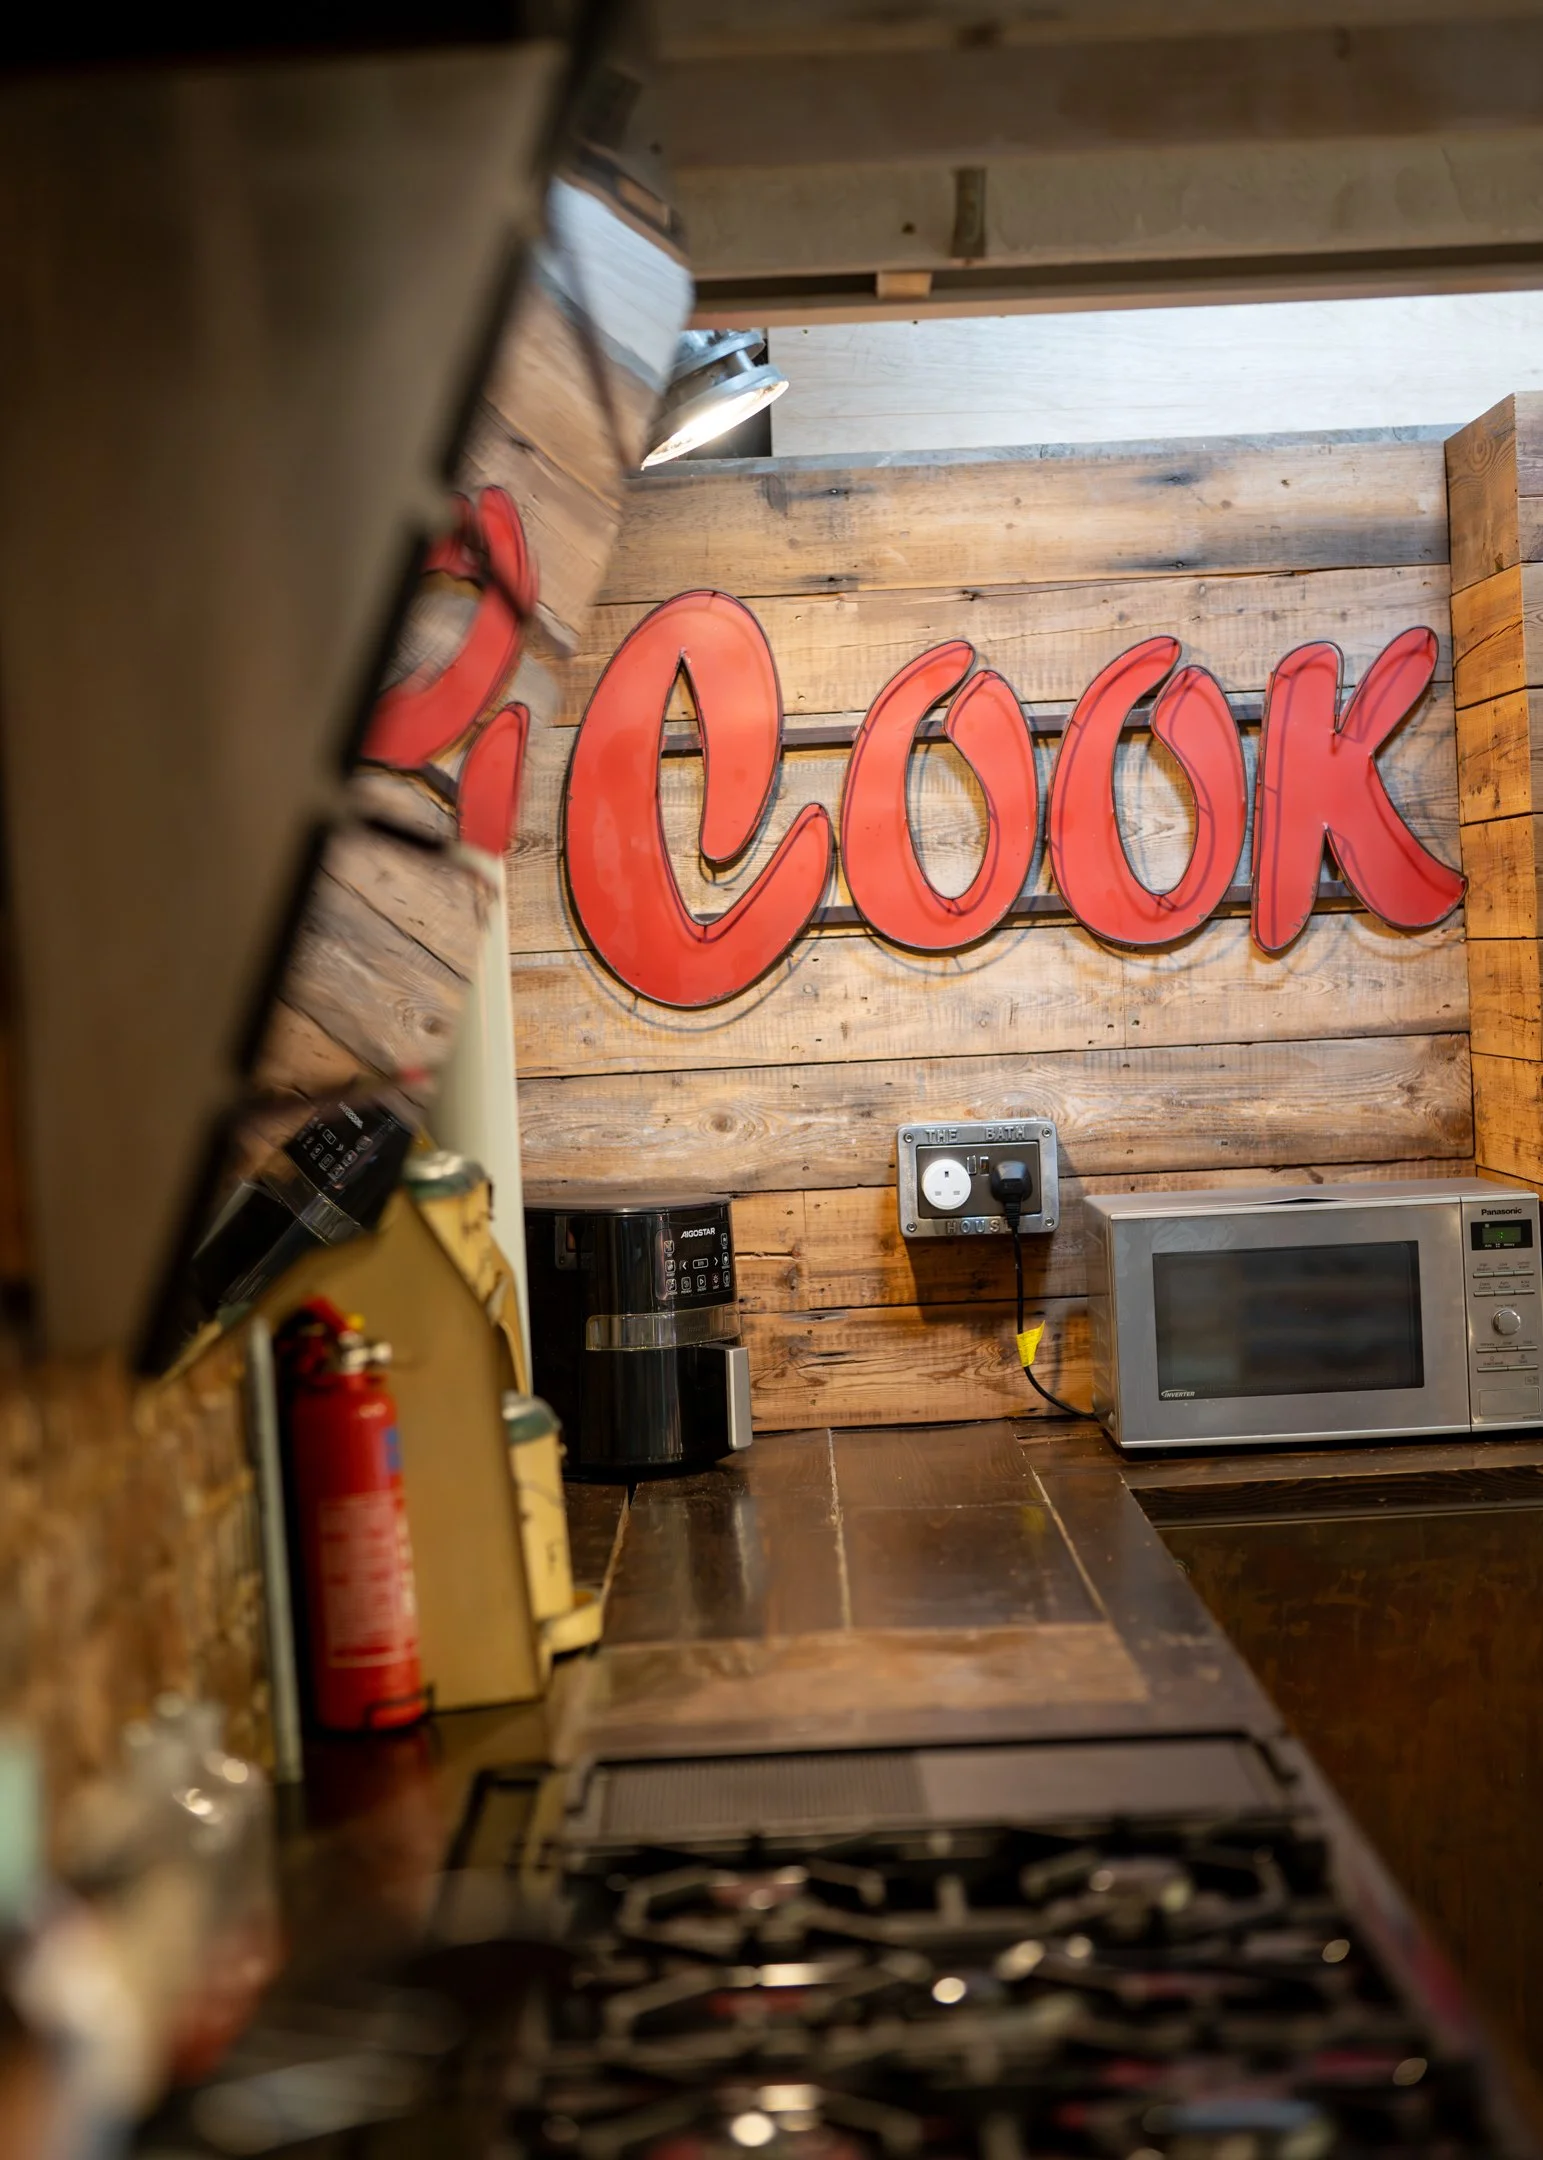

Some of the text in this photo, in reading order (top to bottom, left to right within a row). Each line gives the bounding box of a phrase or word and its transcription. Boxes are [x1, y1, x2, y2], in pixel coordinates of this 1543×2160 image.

[565, 588, 1469, 1008] COOK
[924, 1125, 1026, 1143] THE BATH
[1481, 1207, 1522, 1216] Panasonic
[681, 1227, 716, 1239] AIGOSTAR
